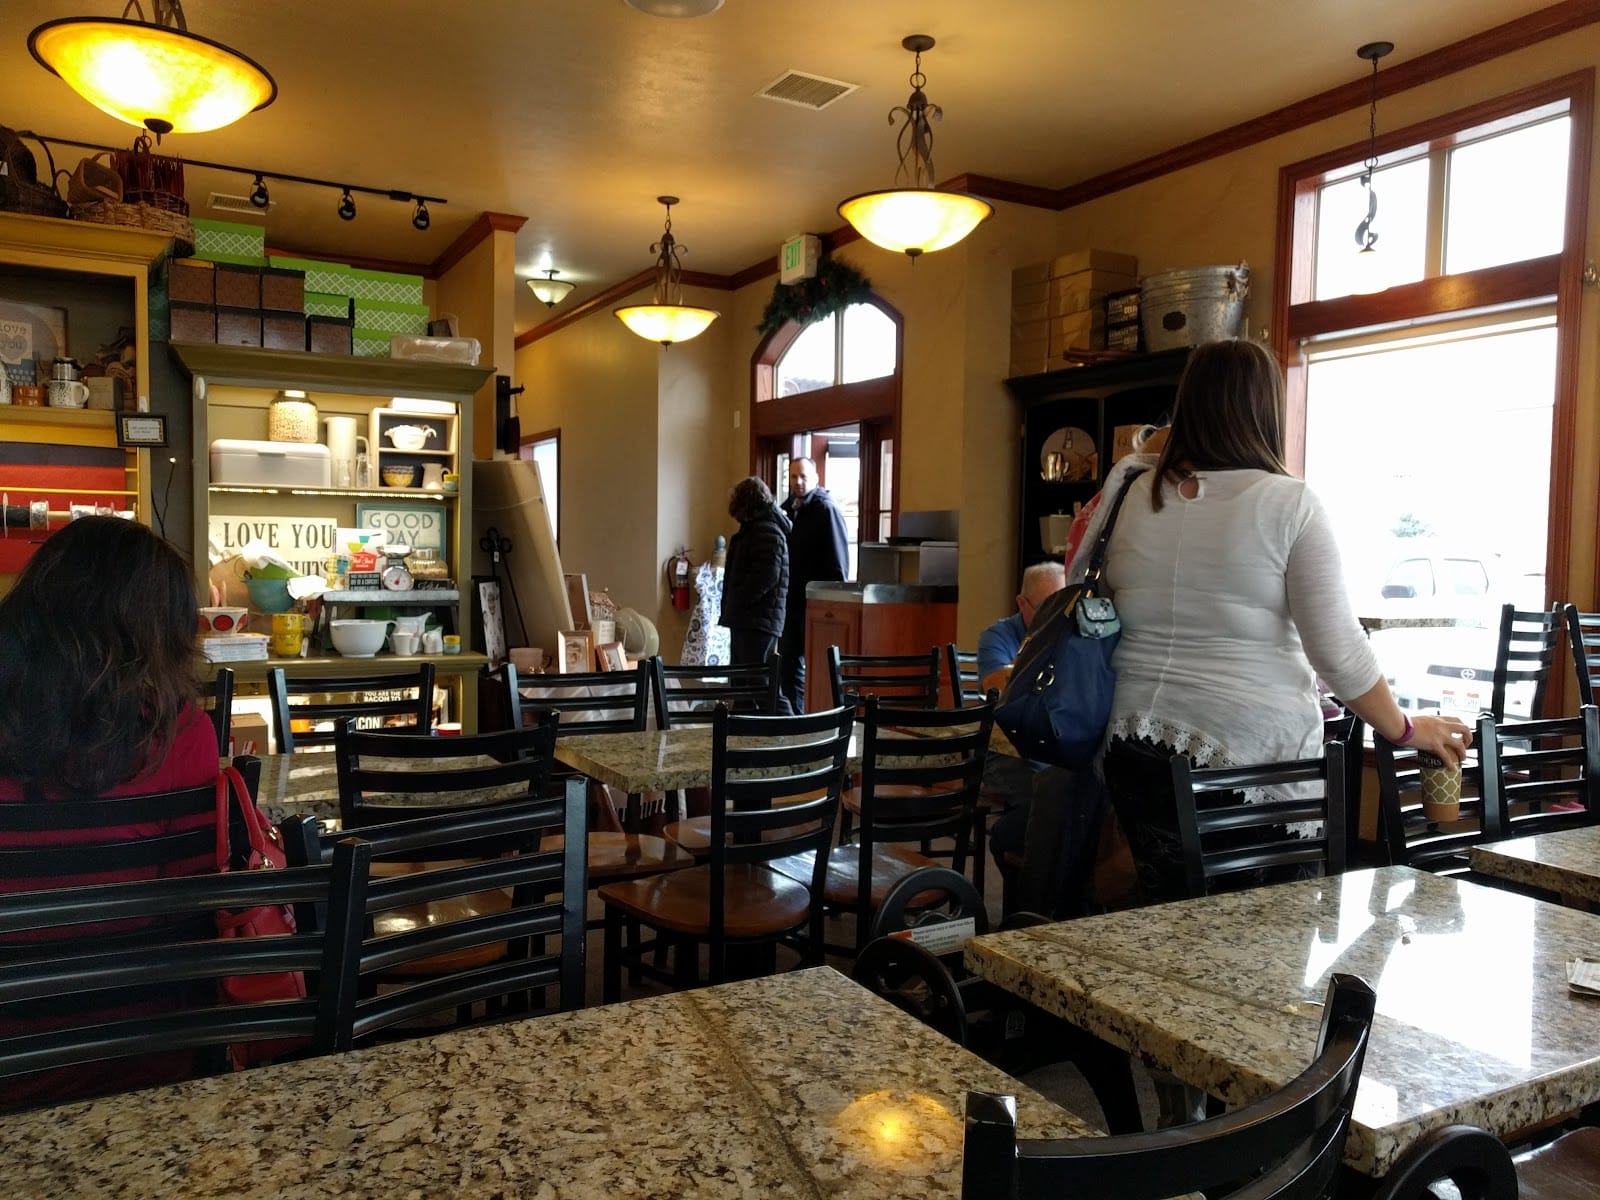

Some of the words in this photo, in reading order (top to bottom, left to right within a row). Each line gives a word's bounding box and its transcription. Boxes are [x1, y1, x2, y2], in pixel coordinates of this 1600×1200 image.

[785, 239, 802, 271] EXIT
[369, 512, 434, 529] GOOD
[224, 522, 279, 549] LOVE
[292, 524, 333, 549] YOU
[386, 529, 420, 546] DAY
[355, 716, 380, 731] CON
